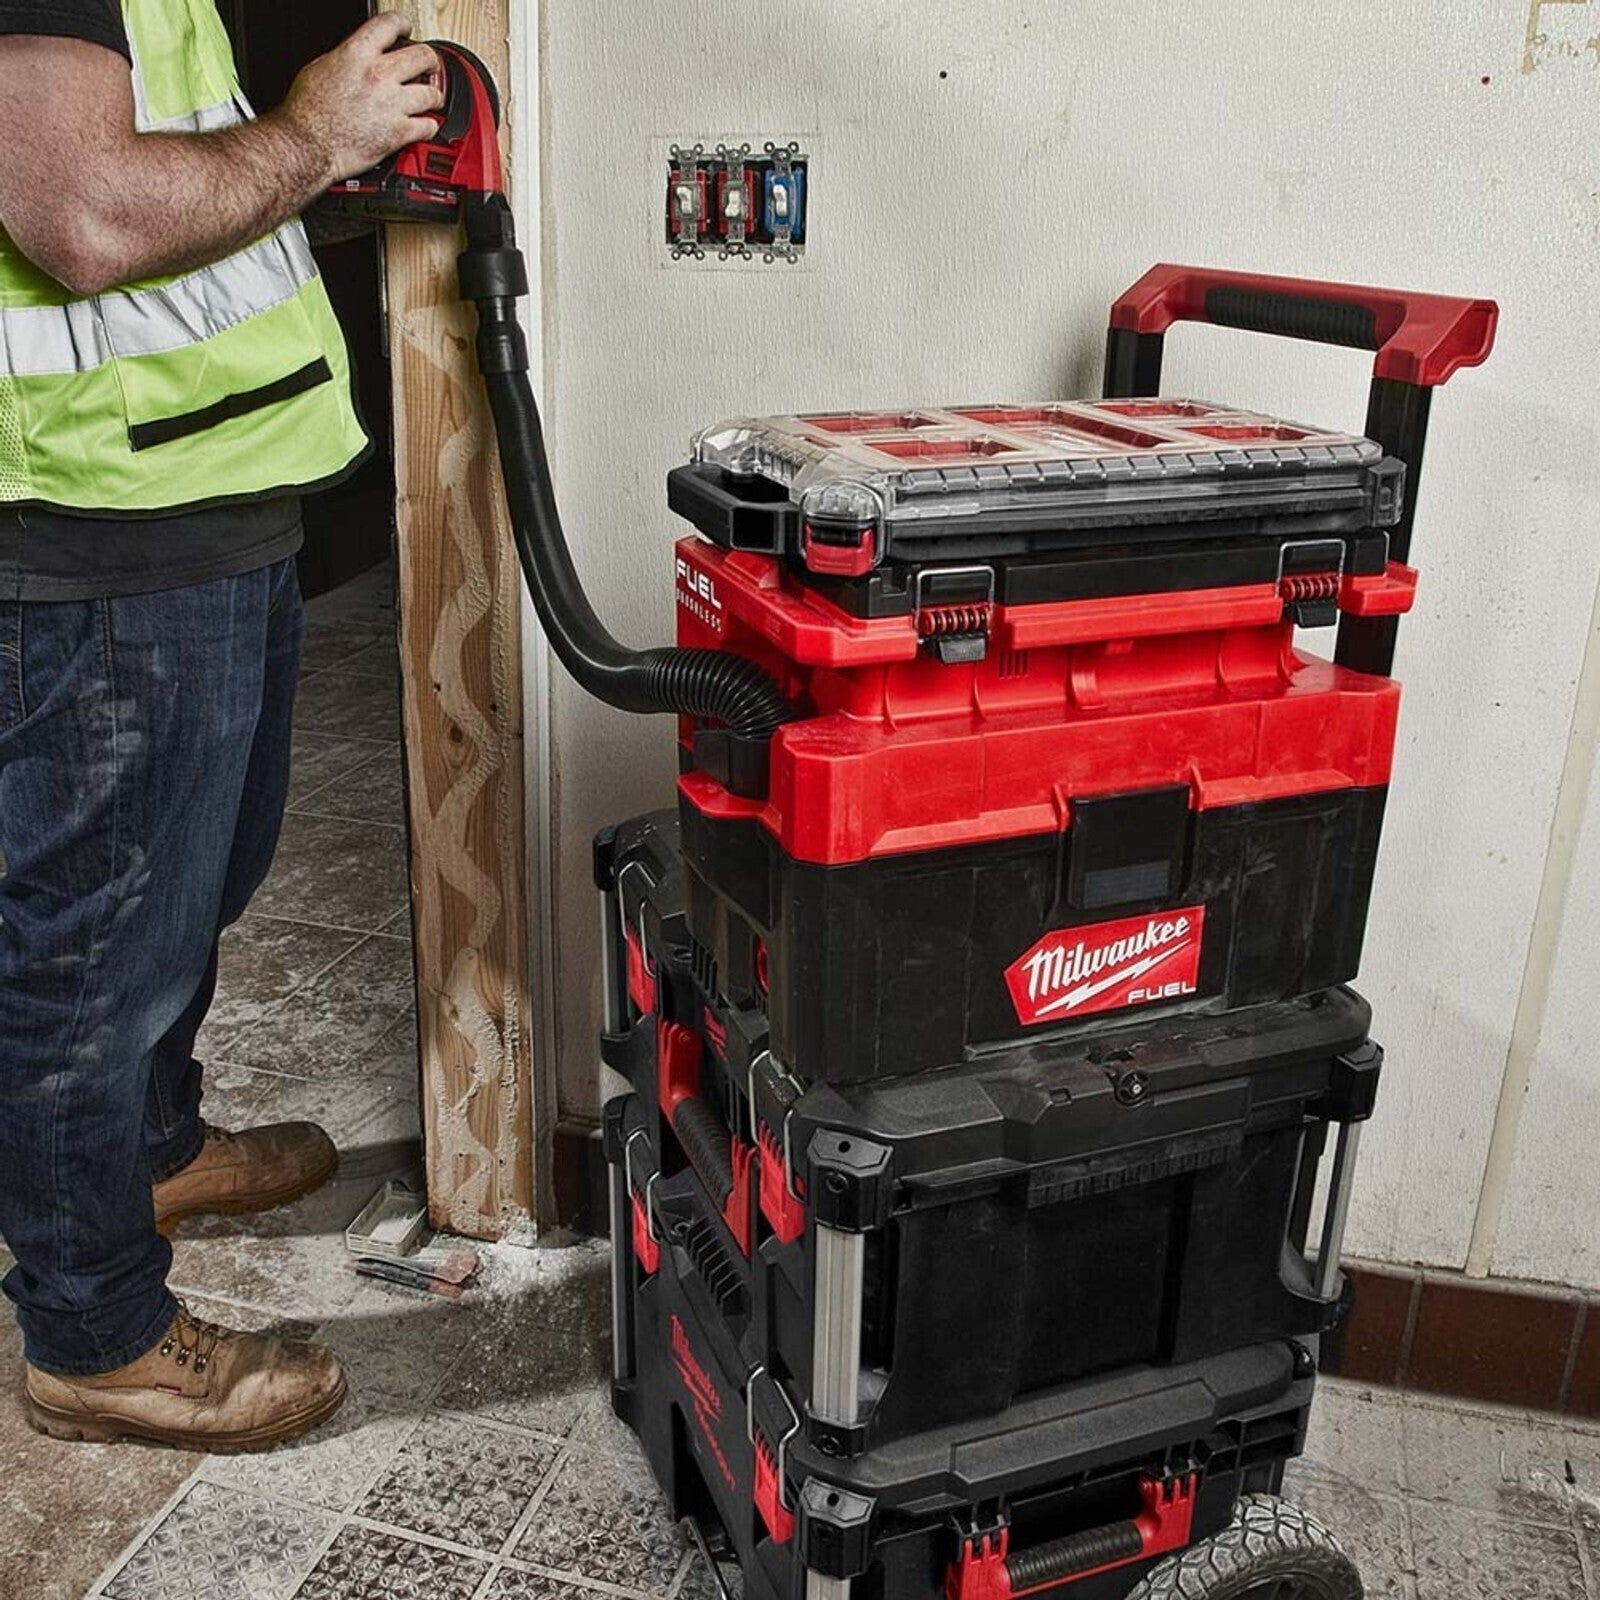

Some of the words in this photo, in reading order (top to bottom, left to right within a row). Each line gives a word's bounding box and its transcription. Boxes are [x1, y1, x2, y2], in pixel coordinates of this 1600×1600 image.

[676, 558, 722, 610] FUEL
[1021, 916, 1190, 1003] Milwaukee
[1127, 981, 1197, 1004] FUEL
